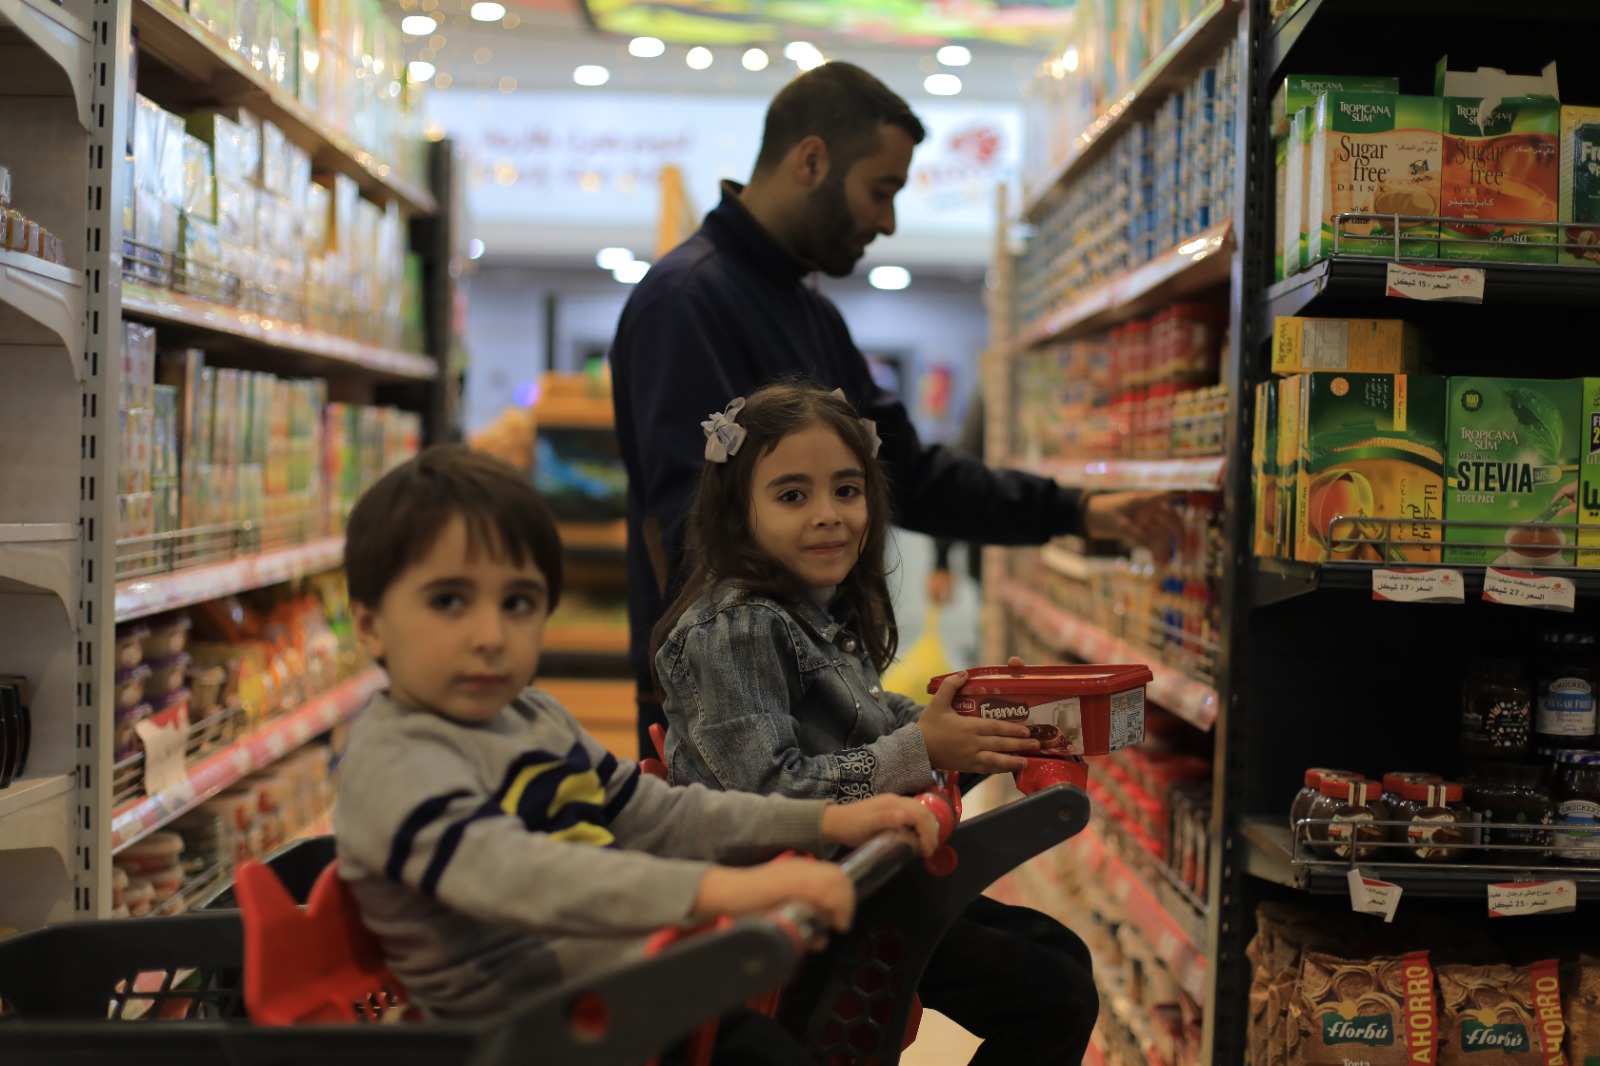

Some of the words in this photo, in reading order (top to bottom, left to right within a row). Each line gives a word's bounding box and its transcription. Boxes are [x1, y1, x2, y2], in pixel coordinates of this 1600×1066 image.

[1300, 80, 1344, 92] TROPICANA
[1339, 101, 1391, 118] TROPICANA
[1351, 113, 1373, 122] SLIM
[1339, 135, 1387, 166] Sugar
[1455, 138, 1502, 168] Sugar
[1353, 158, 1387, 183] free
[1470, 161, 1503, 185] free
[1337, 184, 1387, 193] DRINK
[1454, 186, 1502, 195] DRINK
[1394, 278, 1415, 287] شيكل
[1432, 282, 1450, 290] السعر
[1465, 394, 1479, 403] 100
[1460, 427, 1518, 444] TROPICANA
[1475, 440, 1498, 450] SLIM
[1457, 461, 1533, 493] STEVIA
[1456, 494, 1475, 503] STICK
[1477, 495, 1495, 503] PACK
[1378, 582, 1397, 591] شيكل
[1415, 585, 1433, 593] السعر
[1486, 585, 1507, 595] شيكل
[953, 702, 972, 710] orku
[1492, 901, 1513, 909] شيكل
[1405, 966, 1432, 1064] AHORRO
[1536, 976, 1566, 1066] AHORRO
